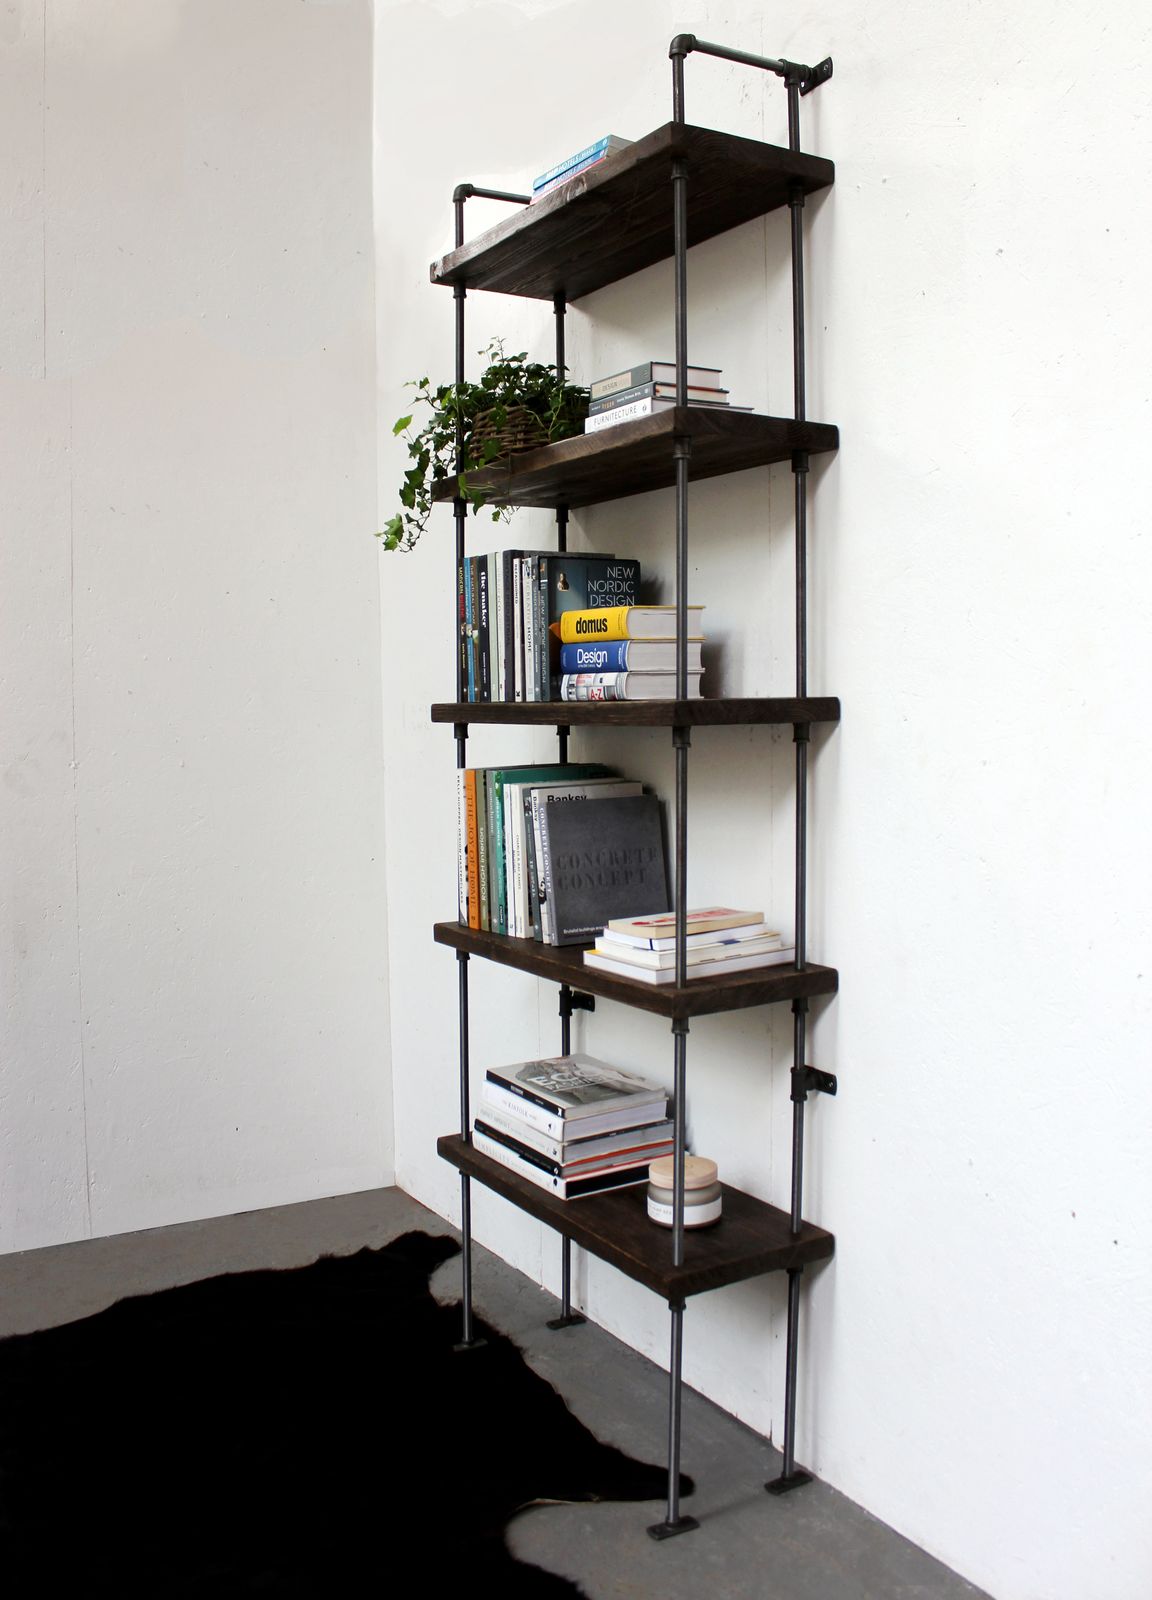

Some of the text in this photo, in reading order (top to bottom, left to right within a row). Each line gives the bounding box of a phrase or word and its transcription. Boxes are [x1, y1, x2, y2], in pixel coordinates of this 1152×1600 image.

[593, 405, 637, 426] FURNITECTURE
[606, 567, 634, 578] NEW
[587, 580, 634, 593] NORDIC
[590, 594, 635, 606] DESIGN
[575, 617, 608, 634] domus
[577, 648, 607, 668] Design
[469, 850, 474, 865] OF
[540, 807, 552, 893] CONCRETE CONCEPT
